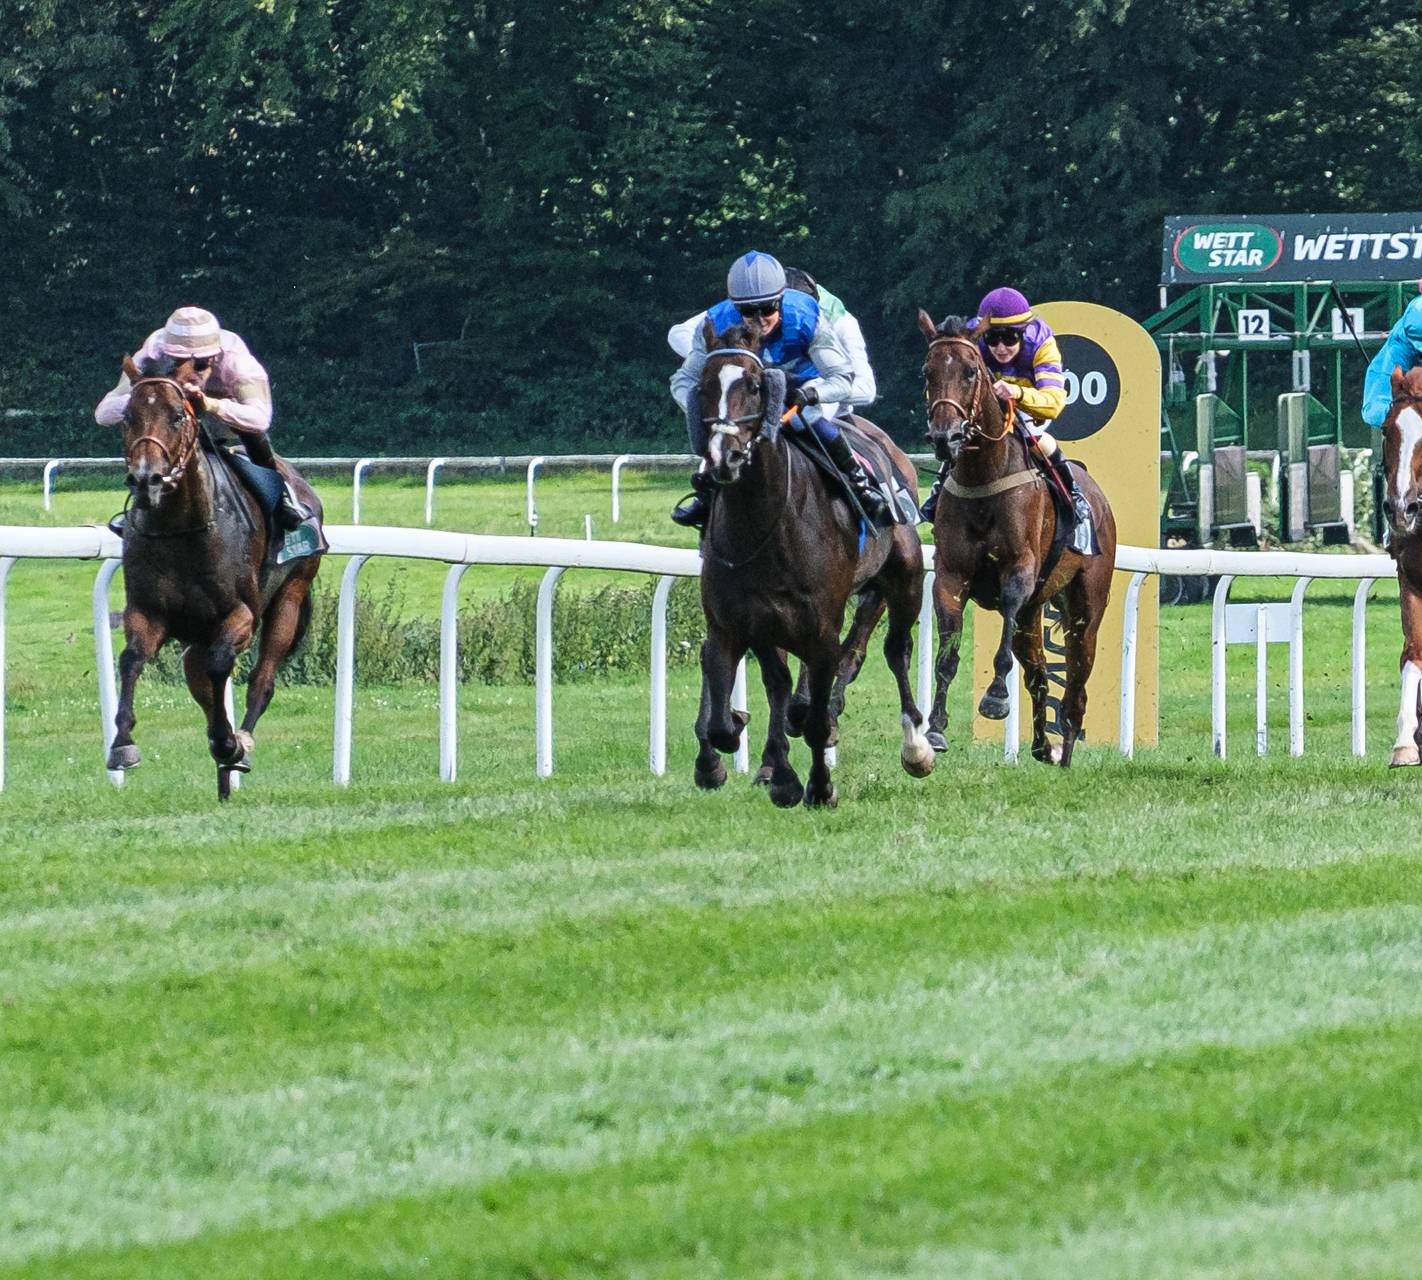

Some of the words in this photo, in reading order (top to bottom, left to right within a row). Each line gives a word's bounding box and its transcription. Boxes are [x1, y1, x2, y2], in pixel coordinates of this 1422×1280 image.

[1193, 231, 1255, 249] WETT
[1208, 249, 1264, 267] STAR
[1242, 315, 1264, 334] 12
[1062, 371, 1108, 405] 00
